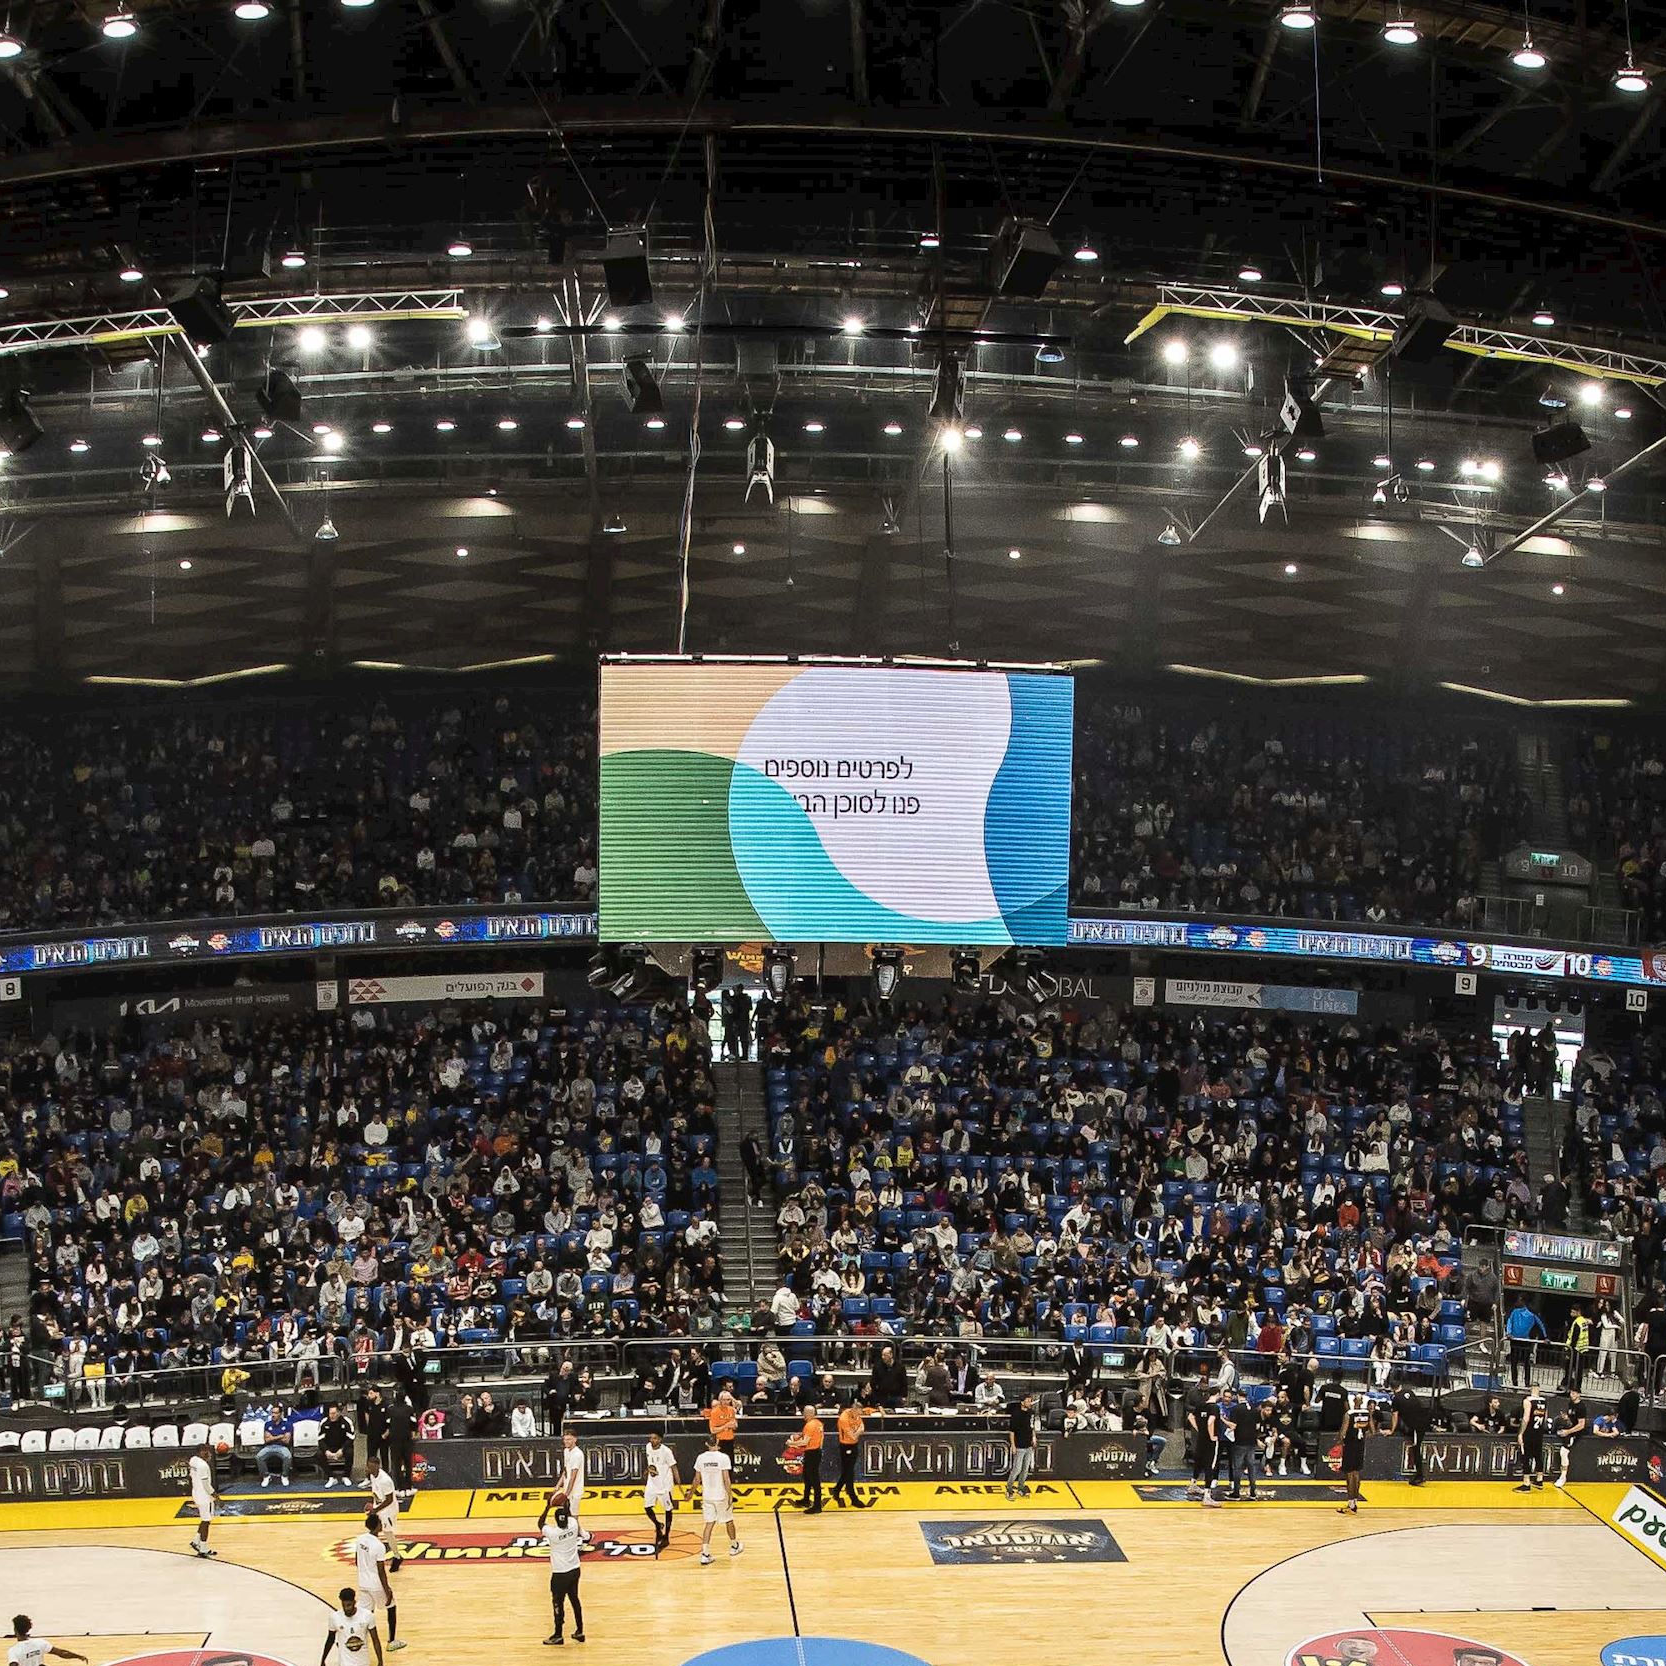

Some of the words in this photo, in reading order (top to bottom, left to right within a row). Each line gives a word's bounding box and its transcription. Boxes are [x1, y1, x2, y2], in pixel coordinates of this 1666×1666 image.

[765, 759, 830, 778] נוספים
[837, 755, 913, 779] לפרטים
[834, 789, 887, 819] לסוכן
[892, 796, 921, 815] פנו
[1471, 946, 1485, 965] 9
[1567, 954, 1591, 976] 10
[446, 981, 493, 993] הפועלים
[499, 981, 518, 992] בנק
[1461, 978, 1471, 990] 9
[1628, 995, 1645, 1007] 10
[863, 1440, 956, 1477] הבאים
[42, 1458, 127, 1494] ברוכים
[941, 1531, 1095, 1546] אולסטאר
[604, 1541, 657, 1556] סל
